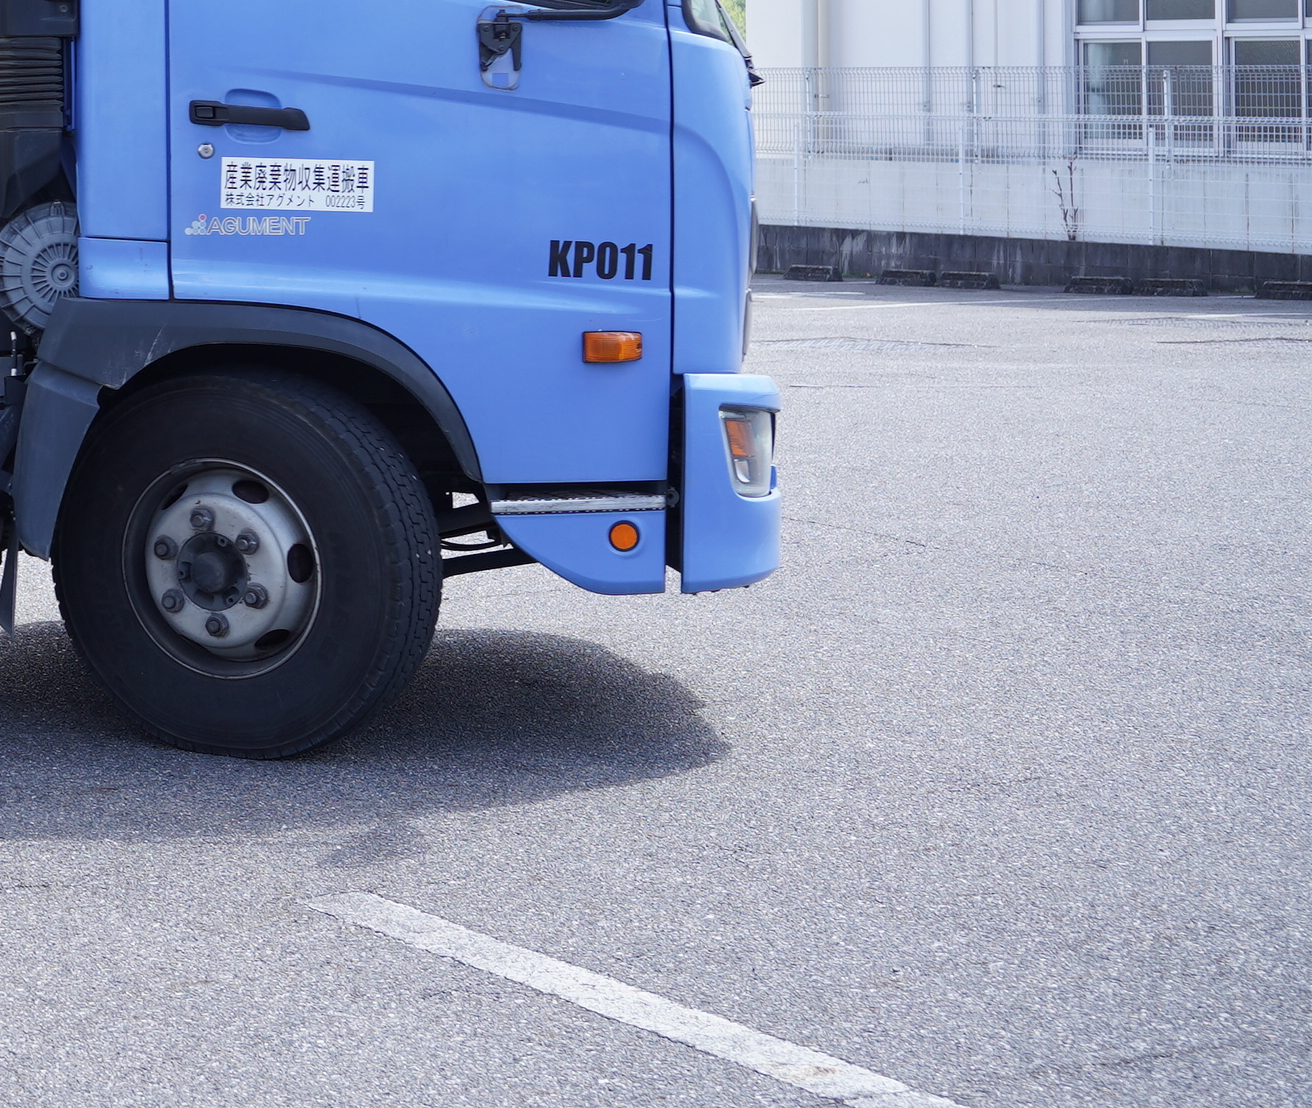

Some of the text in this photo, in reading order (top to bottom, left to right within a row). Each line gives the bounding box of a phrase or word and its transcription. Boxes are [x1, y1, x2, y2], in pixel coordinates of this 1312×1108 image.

[224, 161, 369, 194] 産業廃棄物収集運搬車
[225, 192, 315, 208] 株式会社アグメント
[207, 216, 312, 236] AGUMENT
[547, 239, 654, 281] KP011
